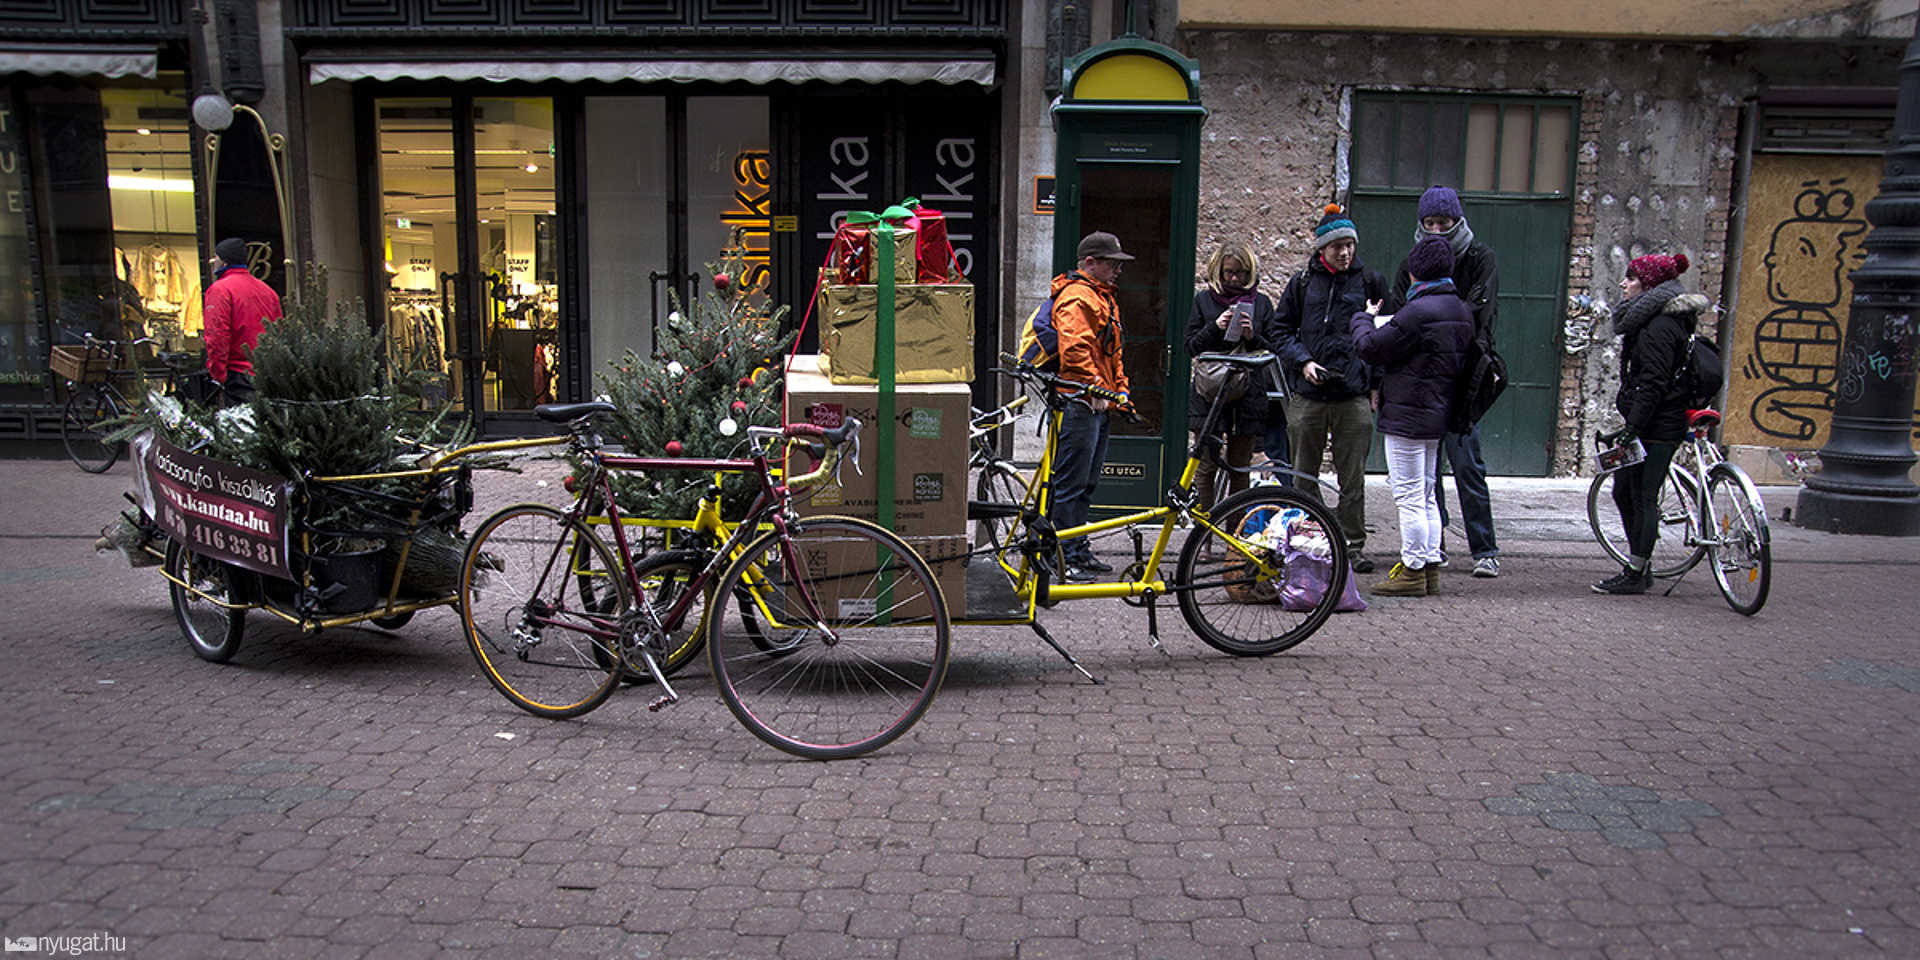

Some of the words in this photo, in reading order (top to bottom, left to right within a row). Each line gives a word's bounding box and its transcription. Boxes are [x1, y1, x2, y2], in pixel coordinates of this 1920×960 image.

[508, 265, 529, 273] ONLY
[1116, 466, 1142, 477] UTCA
[192, 523, 226, 550] 416
[228, 534, 251, 558] 33
[256, 543, 279, 567] 81
